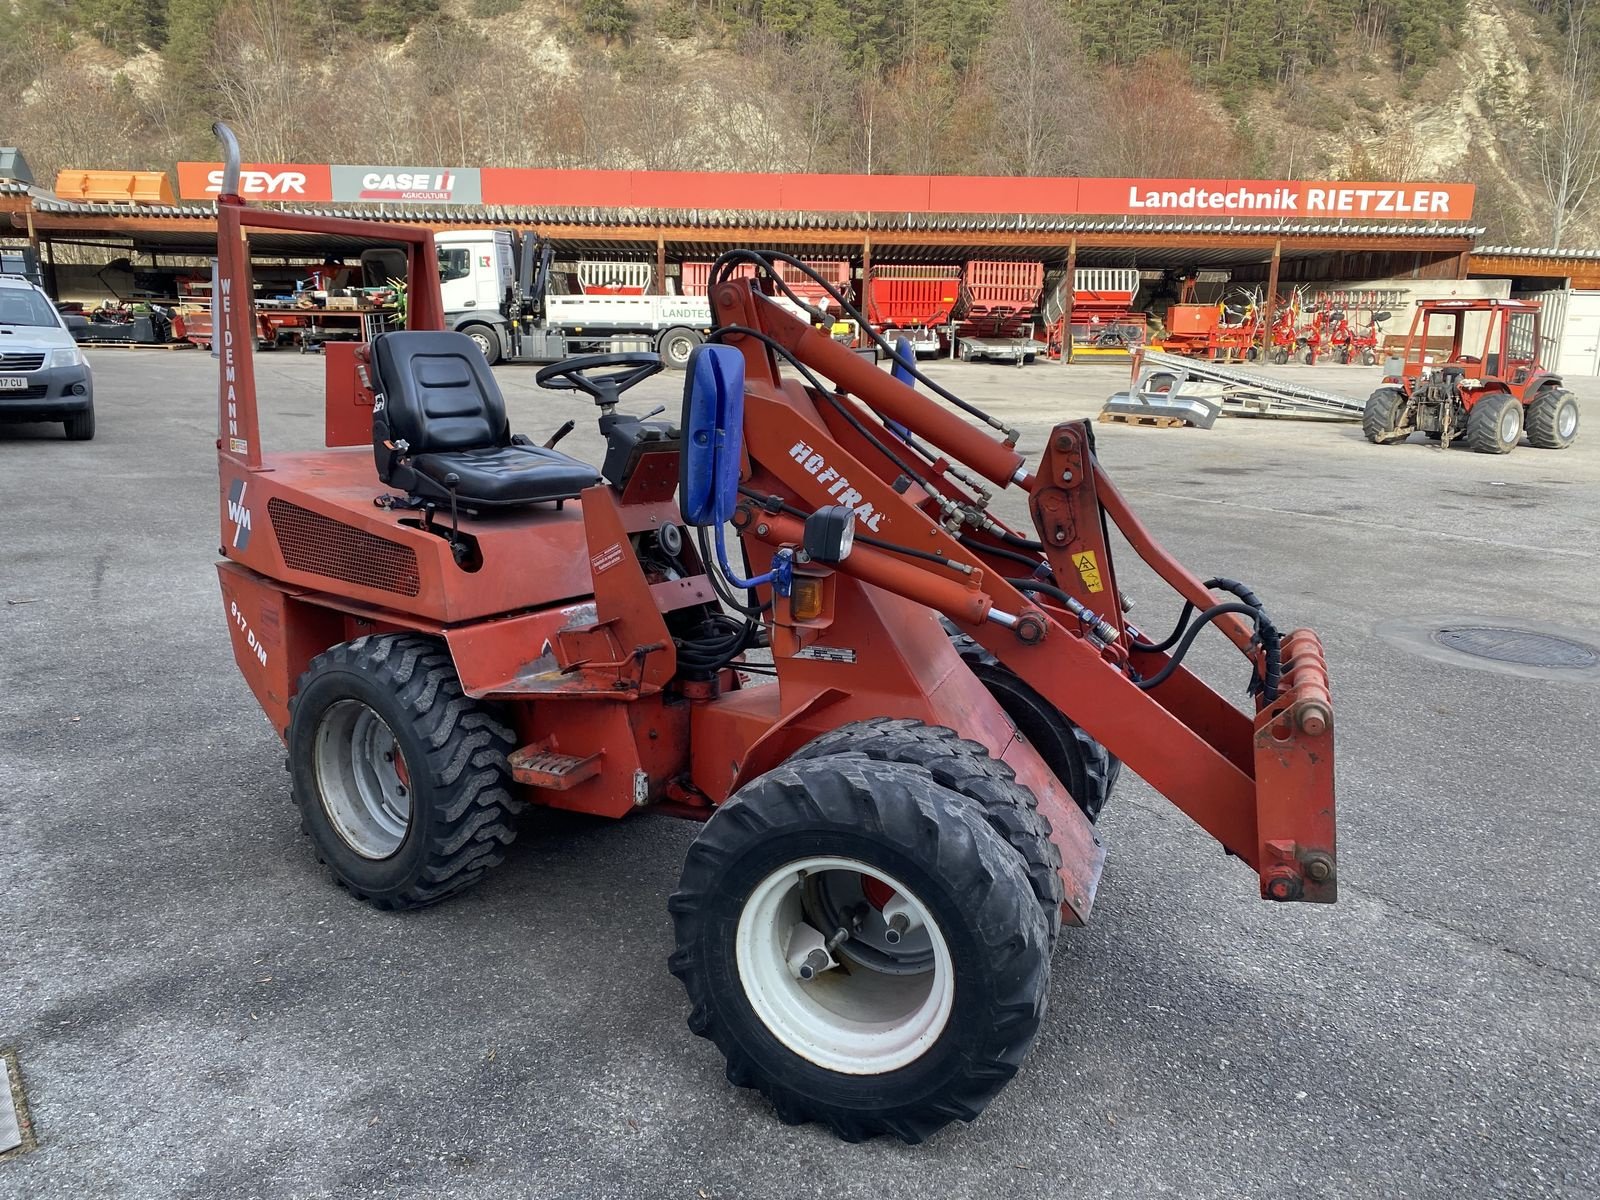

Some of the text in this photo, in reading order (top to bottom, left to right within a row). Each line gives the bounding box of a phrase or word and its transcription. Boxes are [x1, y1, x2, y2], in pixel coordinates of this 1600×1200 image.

[205, 170, 306, 193] SEYR
[362, 173, 430, 191] CASE
[401, 191, 448, 199] AGRICULTURE
[1128, 186, 1450, 212] Landtechnik RIETZLER
[221, 278, 238, 436] WEIDEMANN
[10, 378, 22, 387] CU
